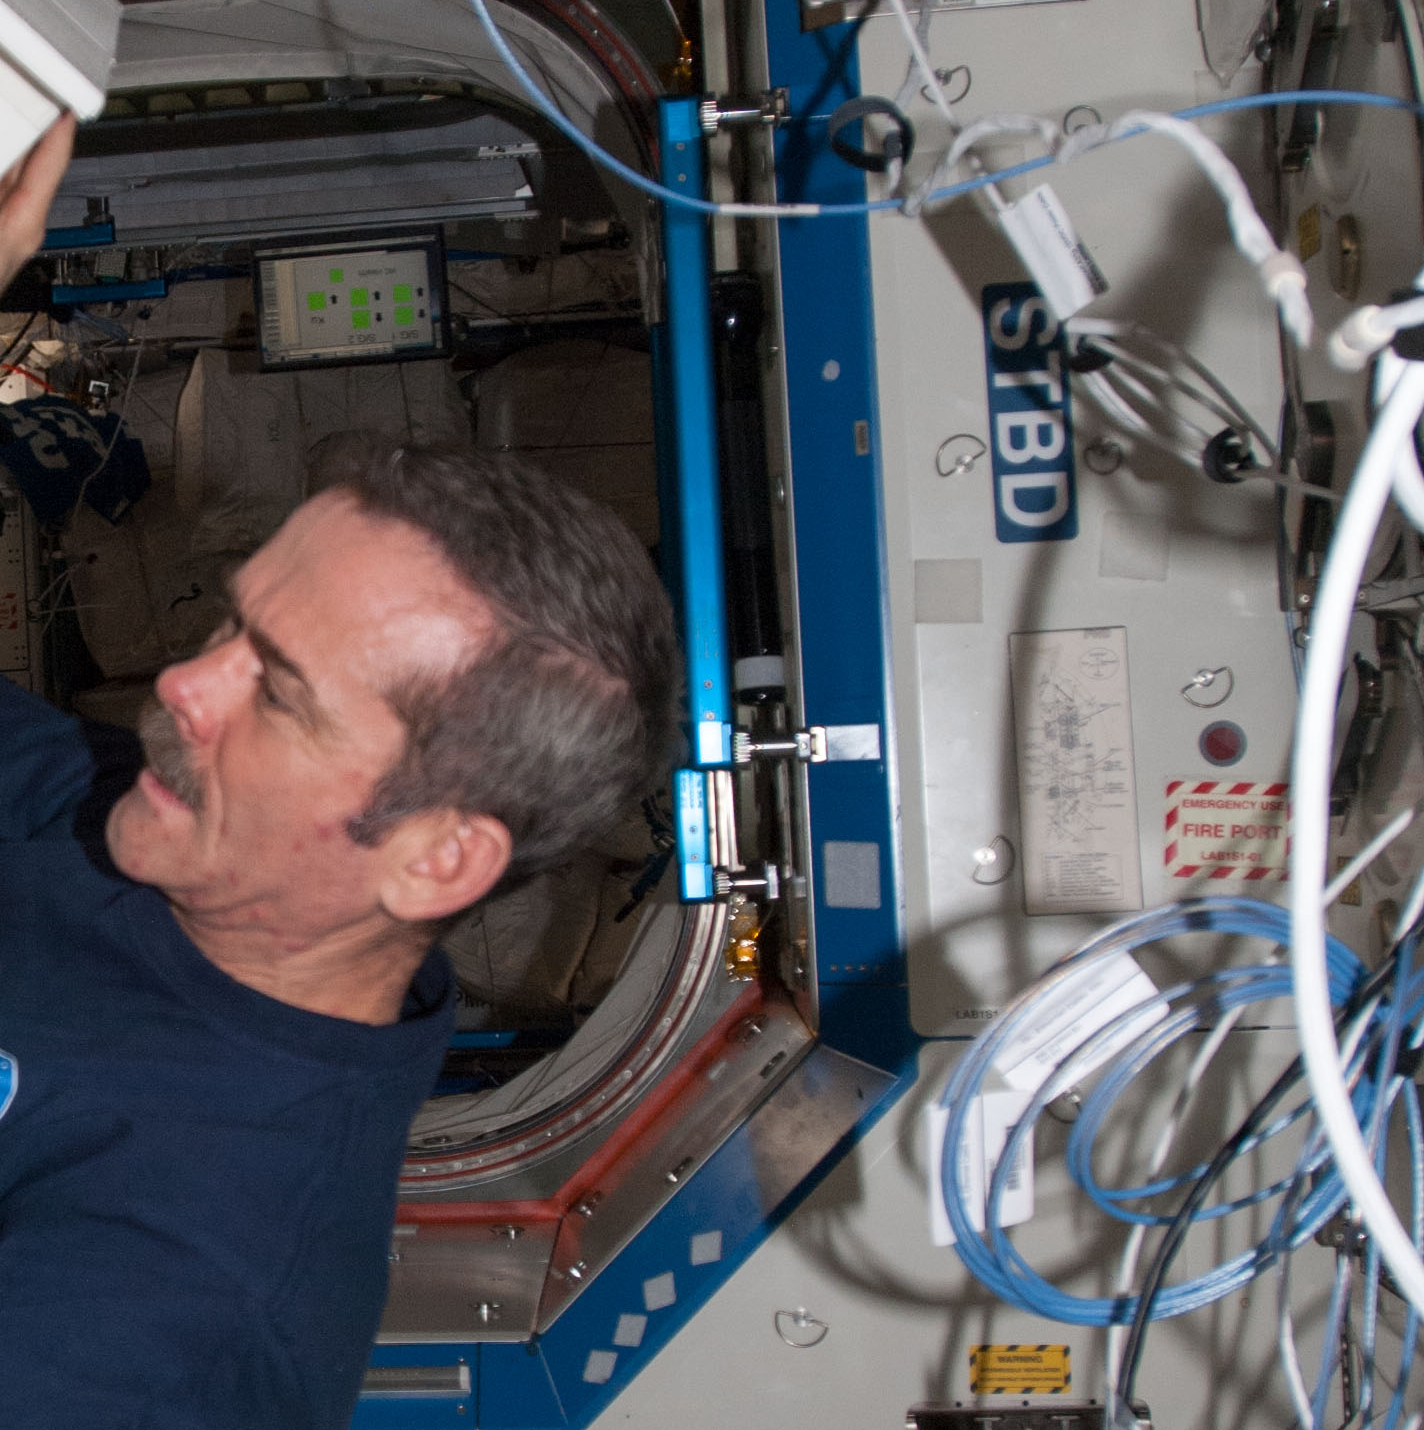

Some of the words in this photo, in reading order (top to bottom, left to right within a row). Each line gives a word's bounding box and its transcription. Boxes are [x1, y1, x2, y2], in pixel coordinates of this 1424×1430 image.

[989, 296, 1070, 528] STBD
[1182, 799, 1257, 810] EMERGENCY
[1260, 801, 1285, 811] USE
[1183, 823, 1225, 838] FIRE
[1231, 825, 1283, 840] PORT
[997, 1355, 1043, 1364] WARNING
